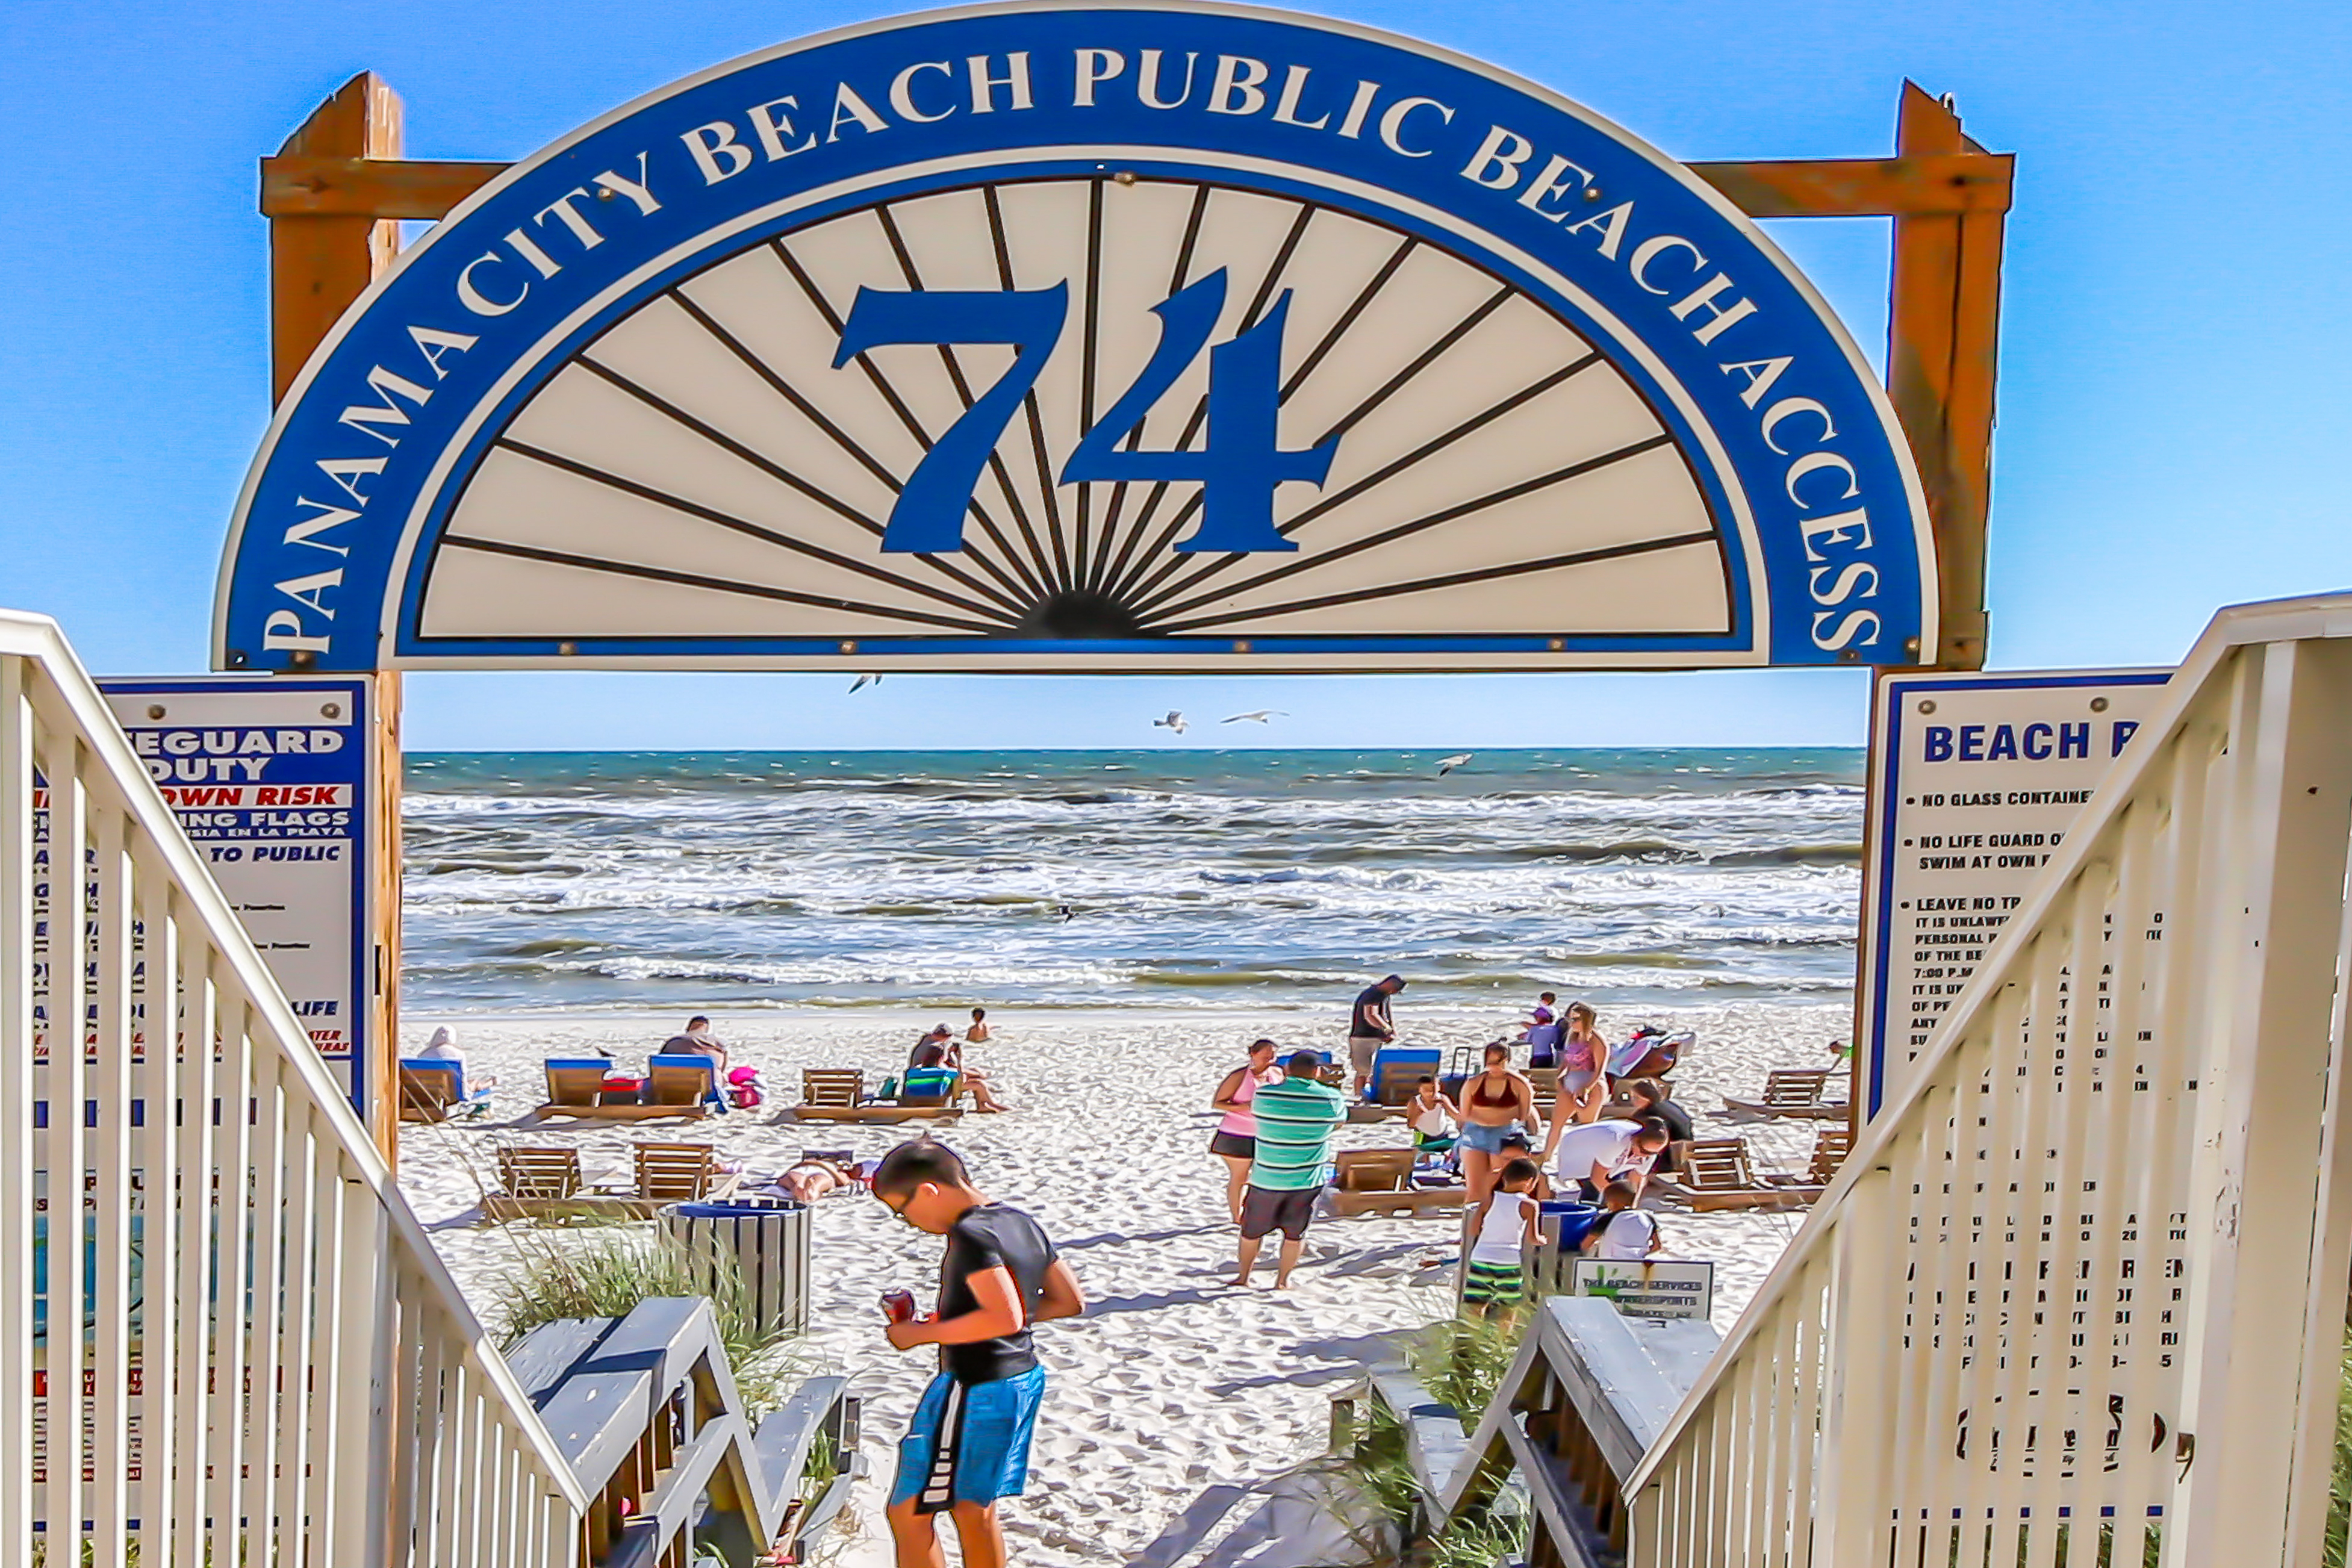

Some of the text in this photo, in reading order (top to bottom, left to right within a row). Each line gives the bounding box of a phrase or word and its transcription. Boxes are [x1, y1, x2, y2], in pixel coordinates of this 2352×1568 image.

[263, 48, 1882, 654] PANAMA CITY BEACH PUBLIC BEACH ACCESS
[830, 265, 1342, 553] 74
[134, 730, 344, 755] EGUARD
[1924, 722, 2090, 762] BEACH
[143, 756, 272, 782] DUTY
[256, 786, 340, 806] RISK
[1922, 789, 2094, 807] NO GLASS CONTAINE
[181, 811, 350, 827] ING FLAGS
[258, 829, 280, 837] LA
[287, 827, 345, 836] PLAYA
[1920, 832, 2065, 849] NO LIFE GUARD O
[210, 845, 341, 862] TO PUBLIC
[1920, 856, 1966, 870] SWIM
[1971, 855, 1992, 869] AT
[1997, 854, 2035, 868] OWN
[1917, 897, 1967, 911] LEAVE
[1973, 897, 1995, 910] NO
[1915, 917, 1929, 928] IT
[1932, 916, 1946, 928] IS
[1915, 933, 1983, 945] PERSONAL
[1914, 951, 1930, 962] OF
[1937, 950, 1961, 961] THE
[1912, 985, 1925, 995] IT
[1929, 985, 1941, 995] IS
[1912, 1001, 1929, 1012] OF
